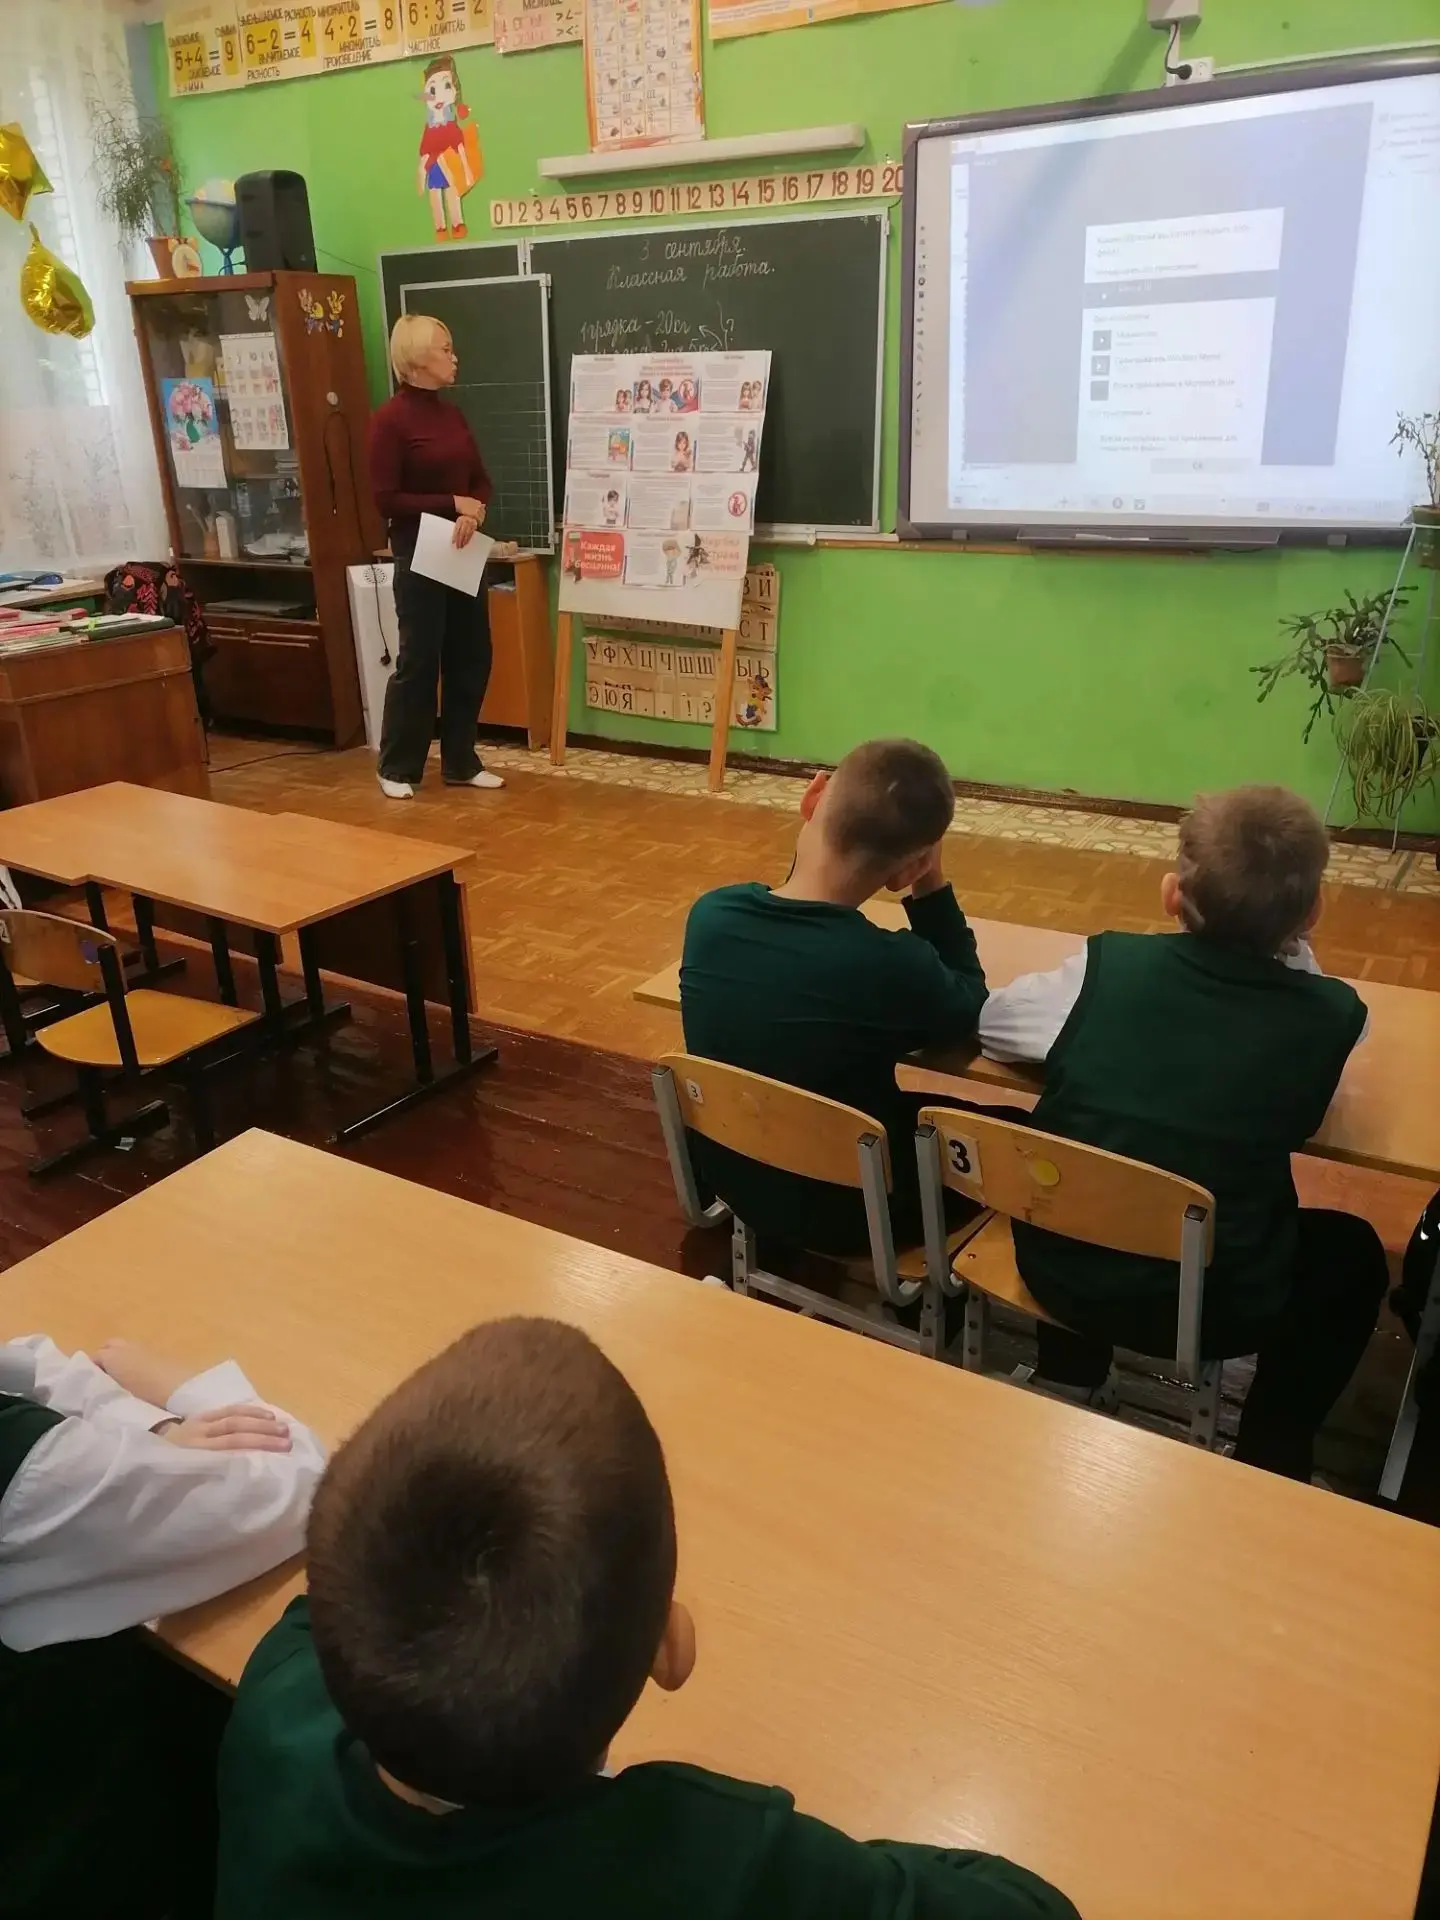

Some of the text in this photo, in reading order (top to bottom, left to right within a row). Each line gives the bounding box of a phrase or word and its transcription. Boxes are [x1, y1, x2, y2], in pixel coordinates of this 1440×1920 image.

[384, 8, 394, 31] 8
[301, 20, 311, 43] 4
[224, 40, 234, 62] 9
[494, 166, 903, 225] 0 1 2 3 4 5 6 7 8 9 10 11 12 13 14 15 16 17 18 19 20
[606, 253, 776, 290] Классная работа.
[739, 619, 750, 638] С
[603, 646, 616, 663] Ф
[622, 646, 635, 666] Х
[660, 652, 672, 671] Ч
[679, 656, 694, 673] Ш
[736, 659, 752, 677] Ы
[589, 686, 599, 703] Э
[604, 688, 617, 706] Ю
[622, 692, 633, 710] Я
[690, 1084, 699, 1098] 3
[948, 1139, 972, 1174] 3
